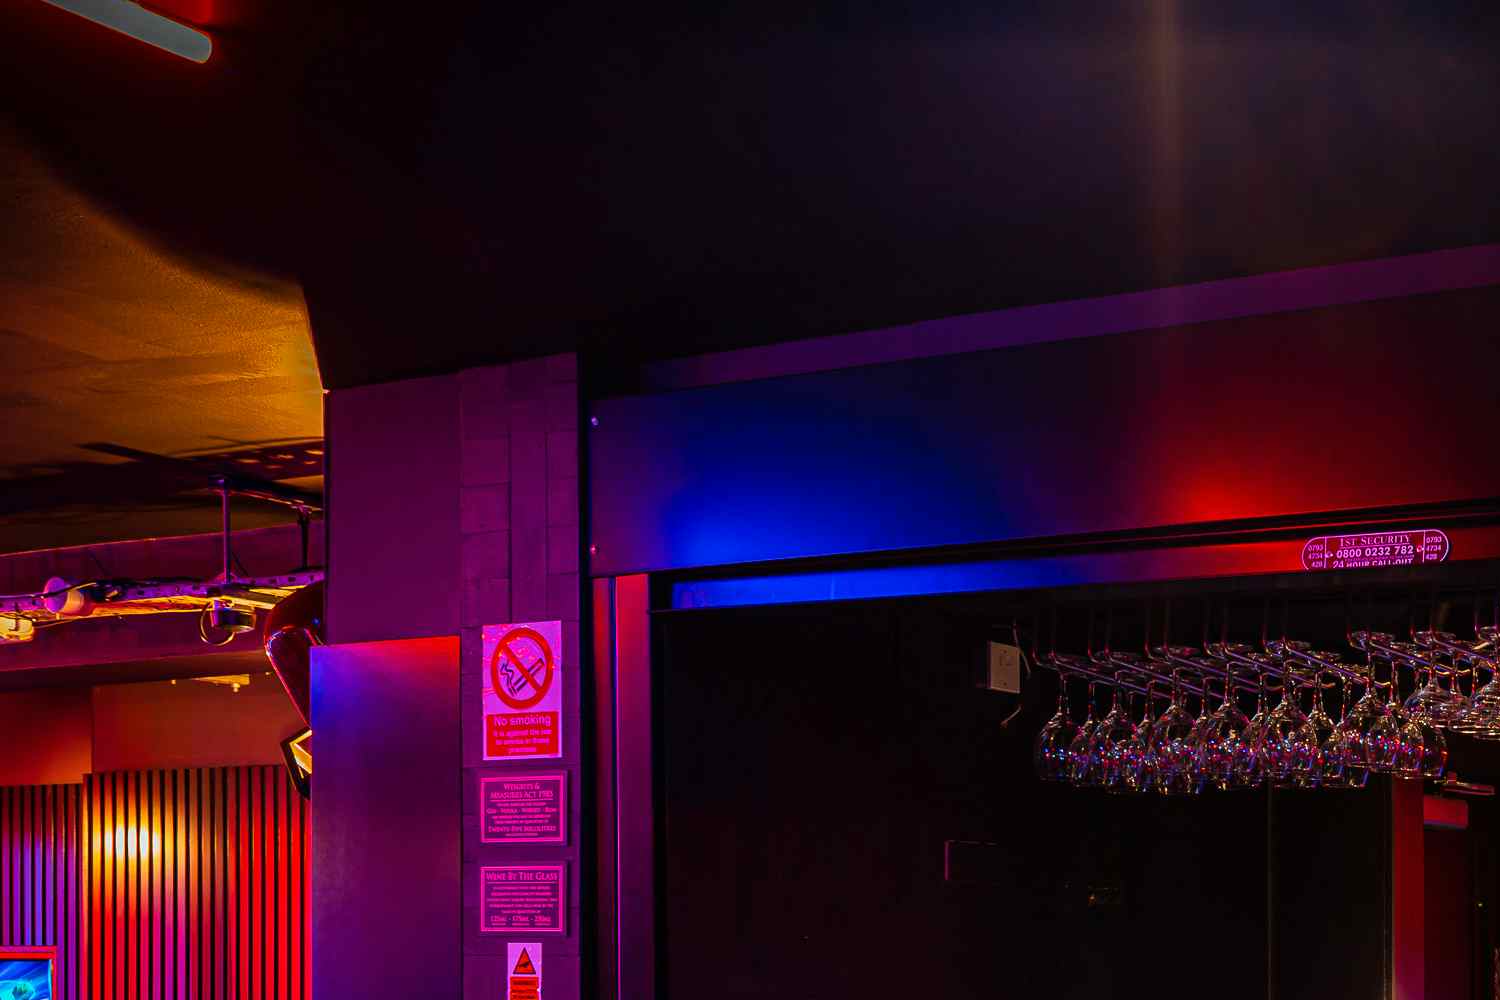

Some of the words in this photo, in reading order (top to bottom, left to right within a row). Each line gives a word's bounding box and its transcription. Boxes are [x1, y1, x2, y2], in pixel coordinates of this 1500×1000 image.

[1361, 534, 1410, 546] SECURITY
[1336, 548, 1362, 559] 0800
[1365, 546, 1391, 557] 0232
[1394, 545, 1414, 555] 782
[495, 716, 508, 727] No
[510, 714, 552, 727] smoking
